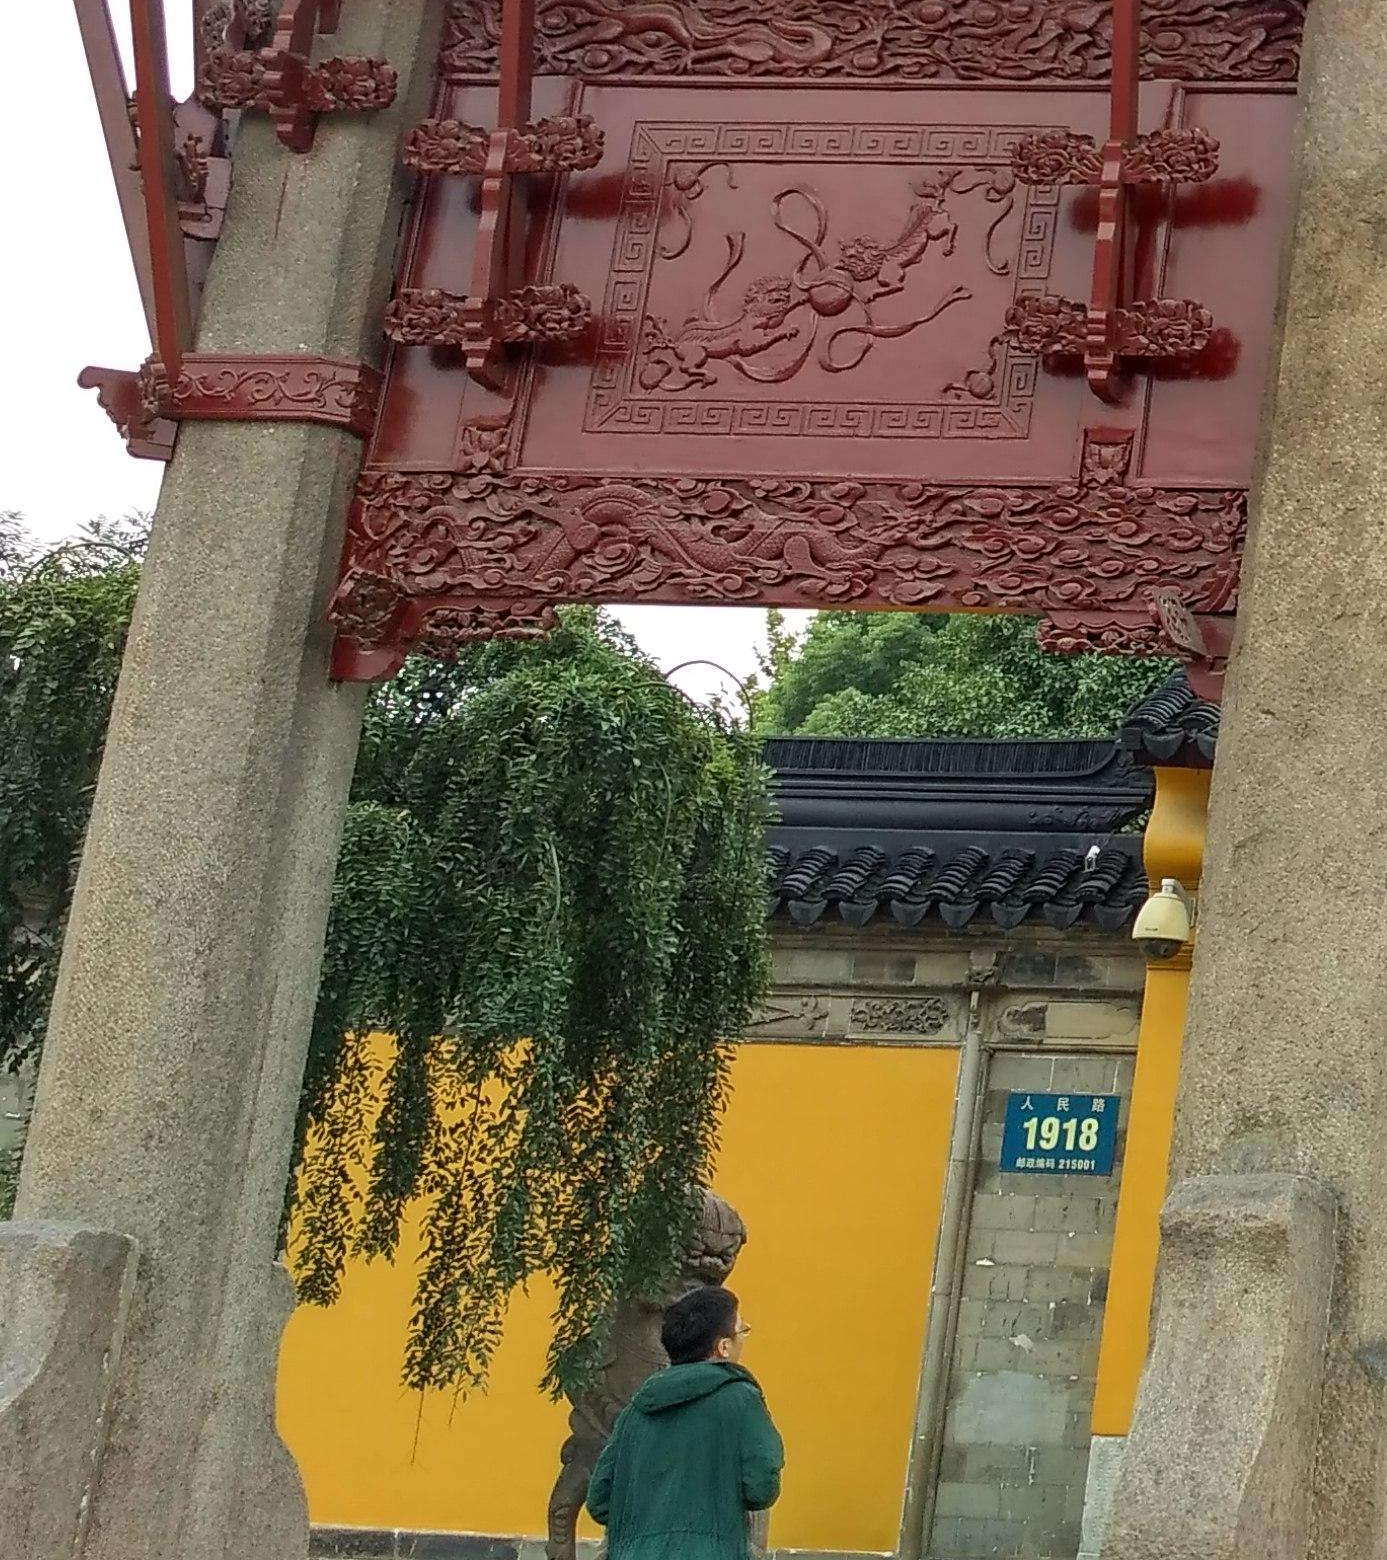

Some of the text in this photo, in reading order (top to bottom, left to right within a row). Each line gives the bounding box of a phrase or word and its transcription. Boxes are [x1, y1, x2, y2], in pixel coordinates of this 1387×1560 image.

[1020, 1096, 1106, 1113] 人民路
[1023, 1116, 1099, 1151] 1918
[1016, 1157, 1096, 1171] 邮政编码 215001
